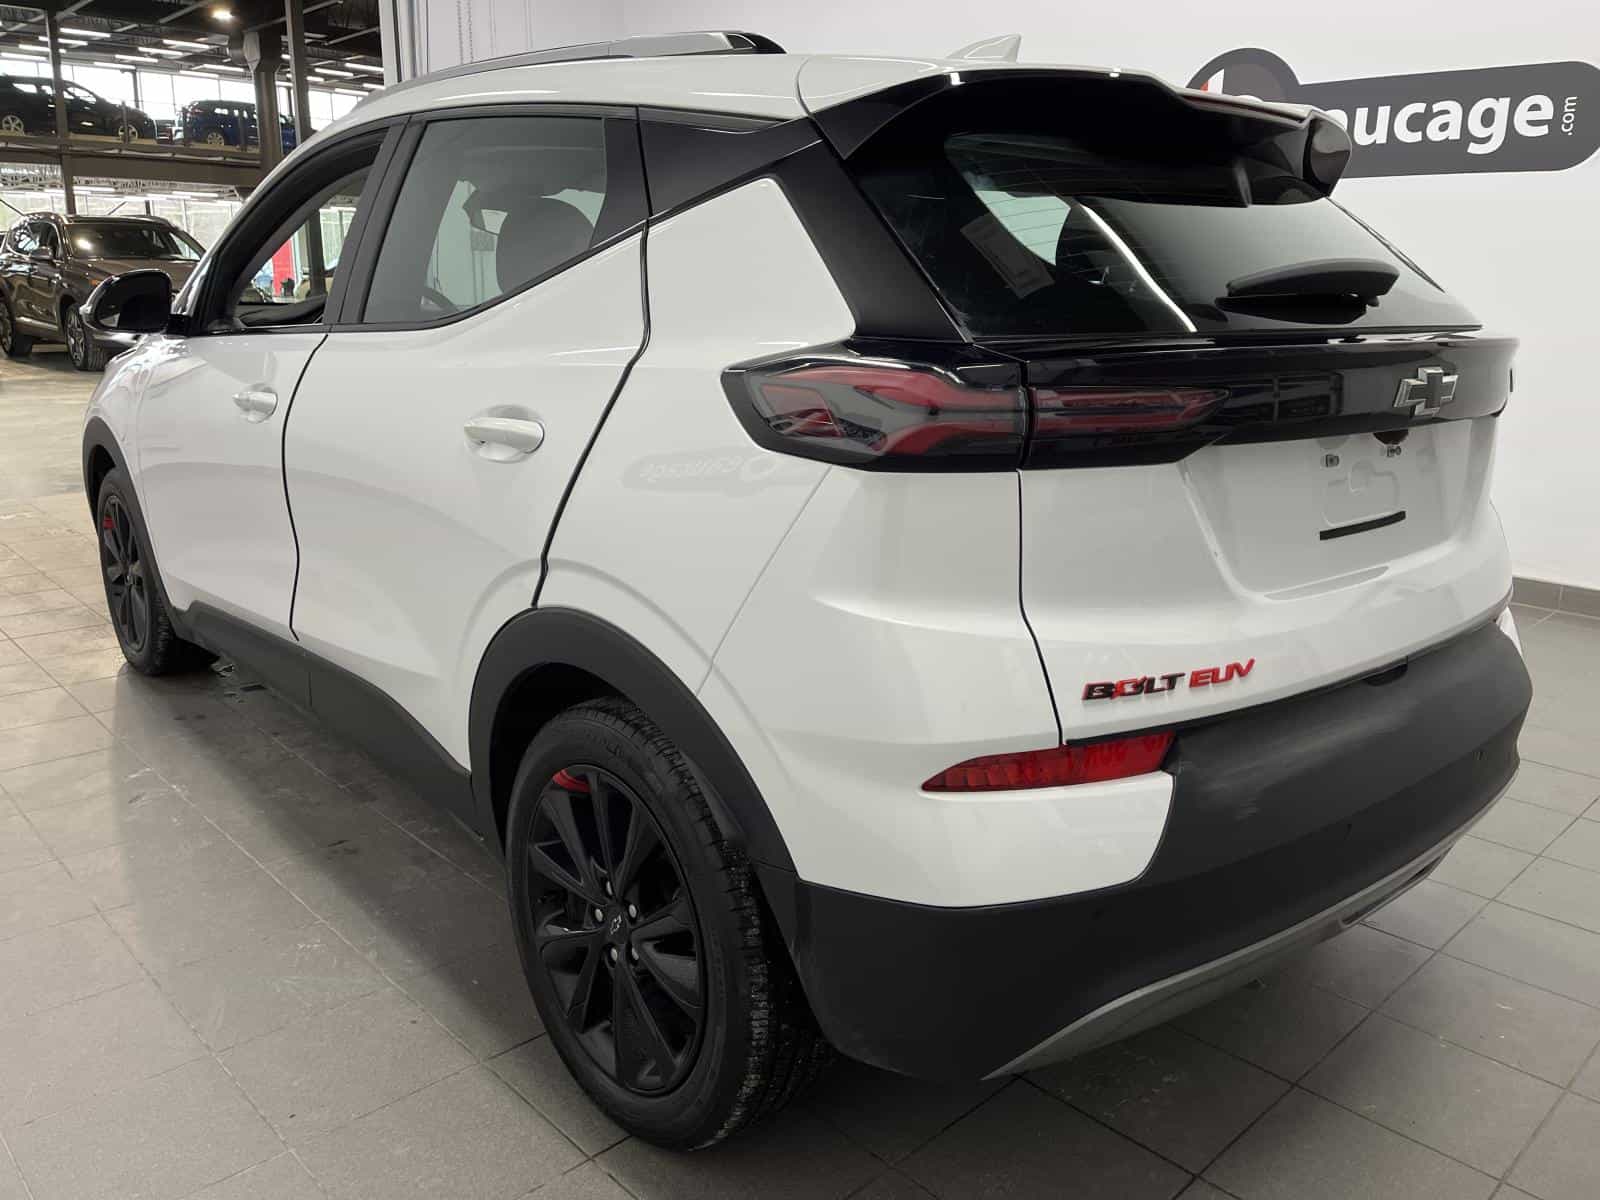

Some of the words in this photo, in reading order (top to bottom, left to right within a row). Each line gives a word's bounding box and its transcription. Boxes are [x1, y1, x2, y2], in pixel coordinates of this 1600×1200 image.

[1561, 96, 1577, 136] .com
[1082, 672, 1186, 701] BOLT
[1189, 658, 1256, 689] EUV
